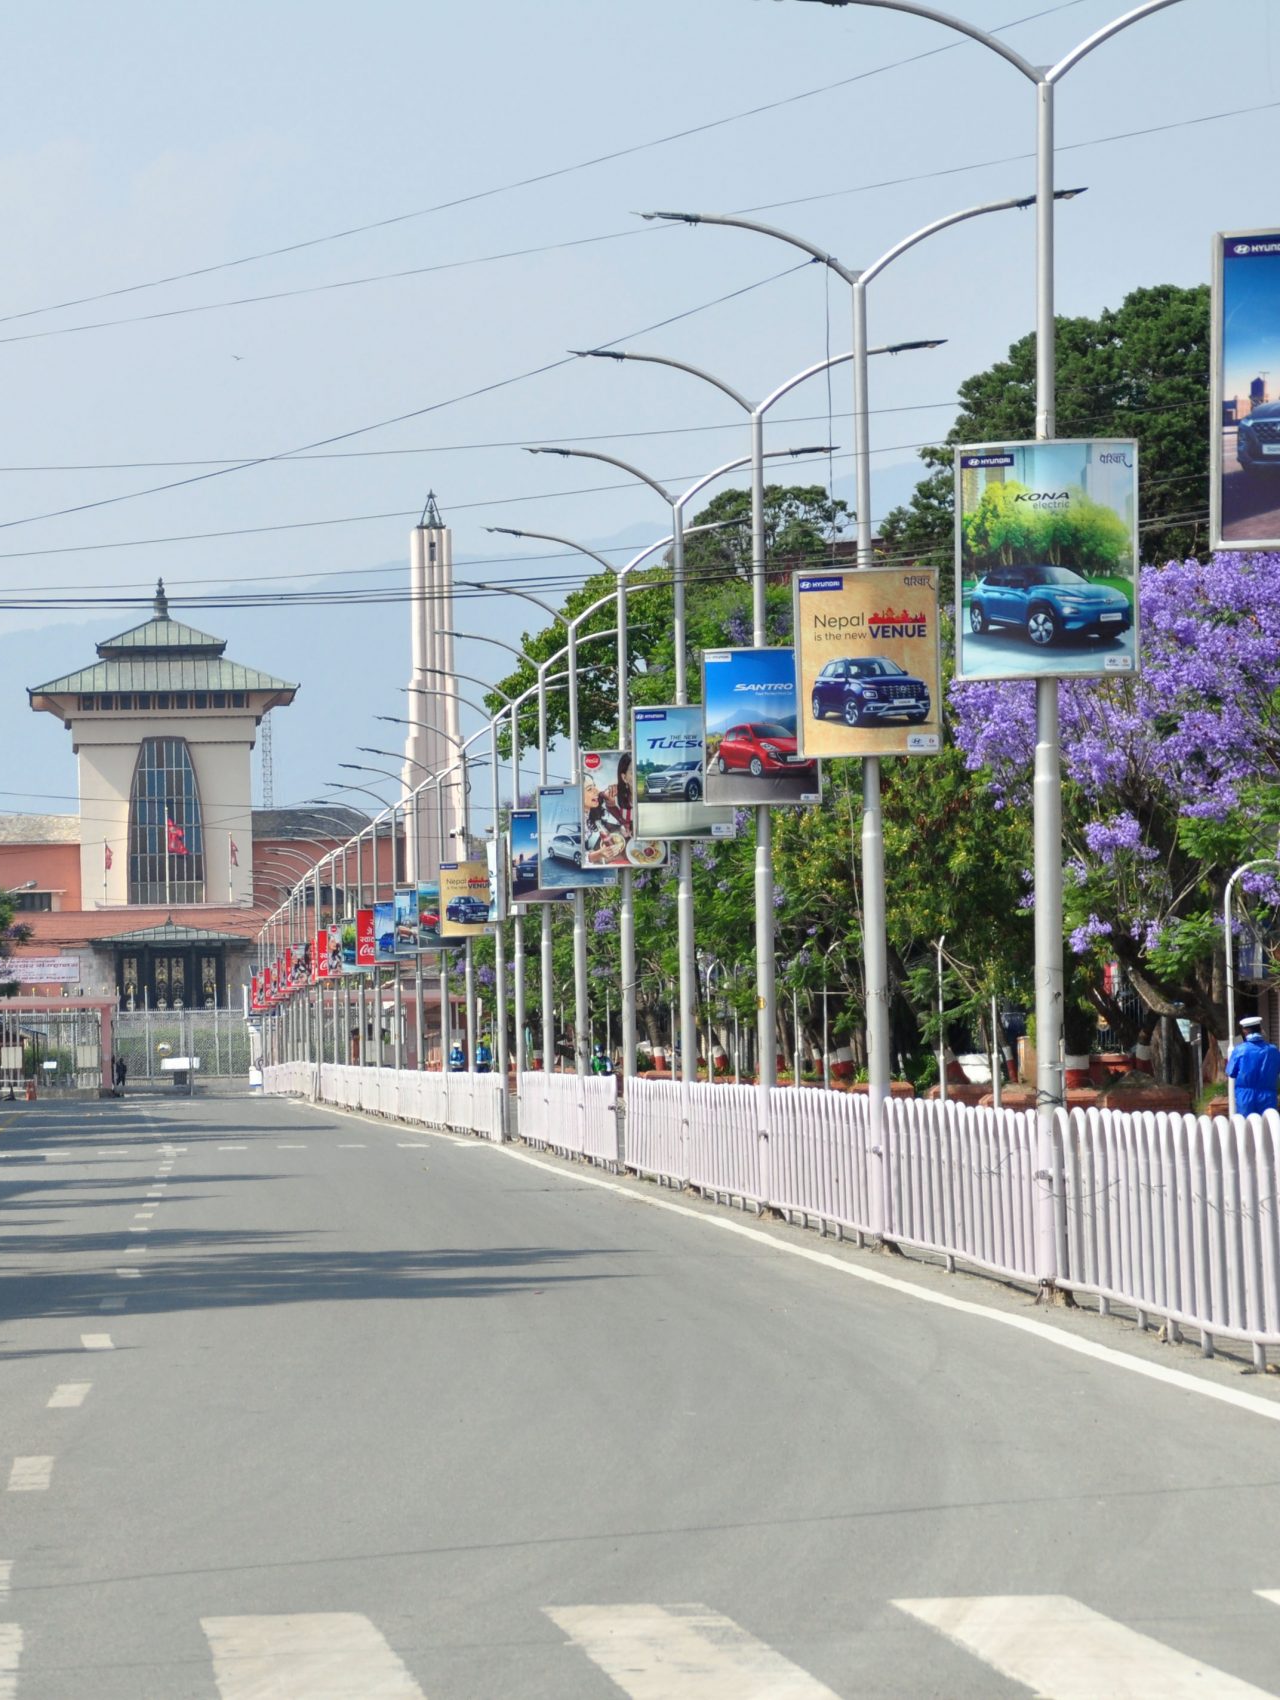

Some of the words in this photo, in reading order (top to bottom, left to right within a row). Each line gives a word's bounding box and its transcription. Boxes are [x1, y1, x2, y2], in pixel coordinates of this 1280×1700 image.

[1014, 492, 1070, 502] KONA
[1032, 500, 1070, 510] electric
[814, 613, 865, 630] Nepal
[814, 633, 822, 642] is
[825, 632, 842, 641] the
[868, 624, 927, 638] VENUE
[733, 683, 794, 691] SANTRO
[446, 878, 467, 886] Nepal
